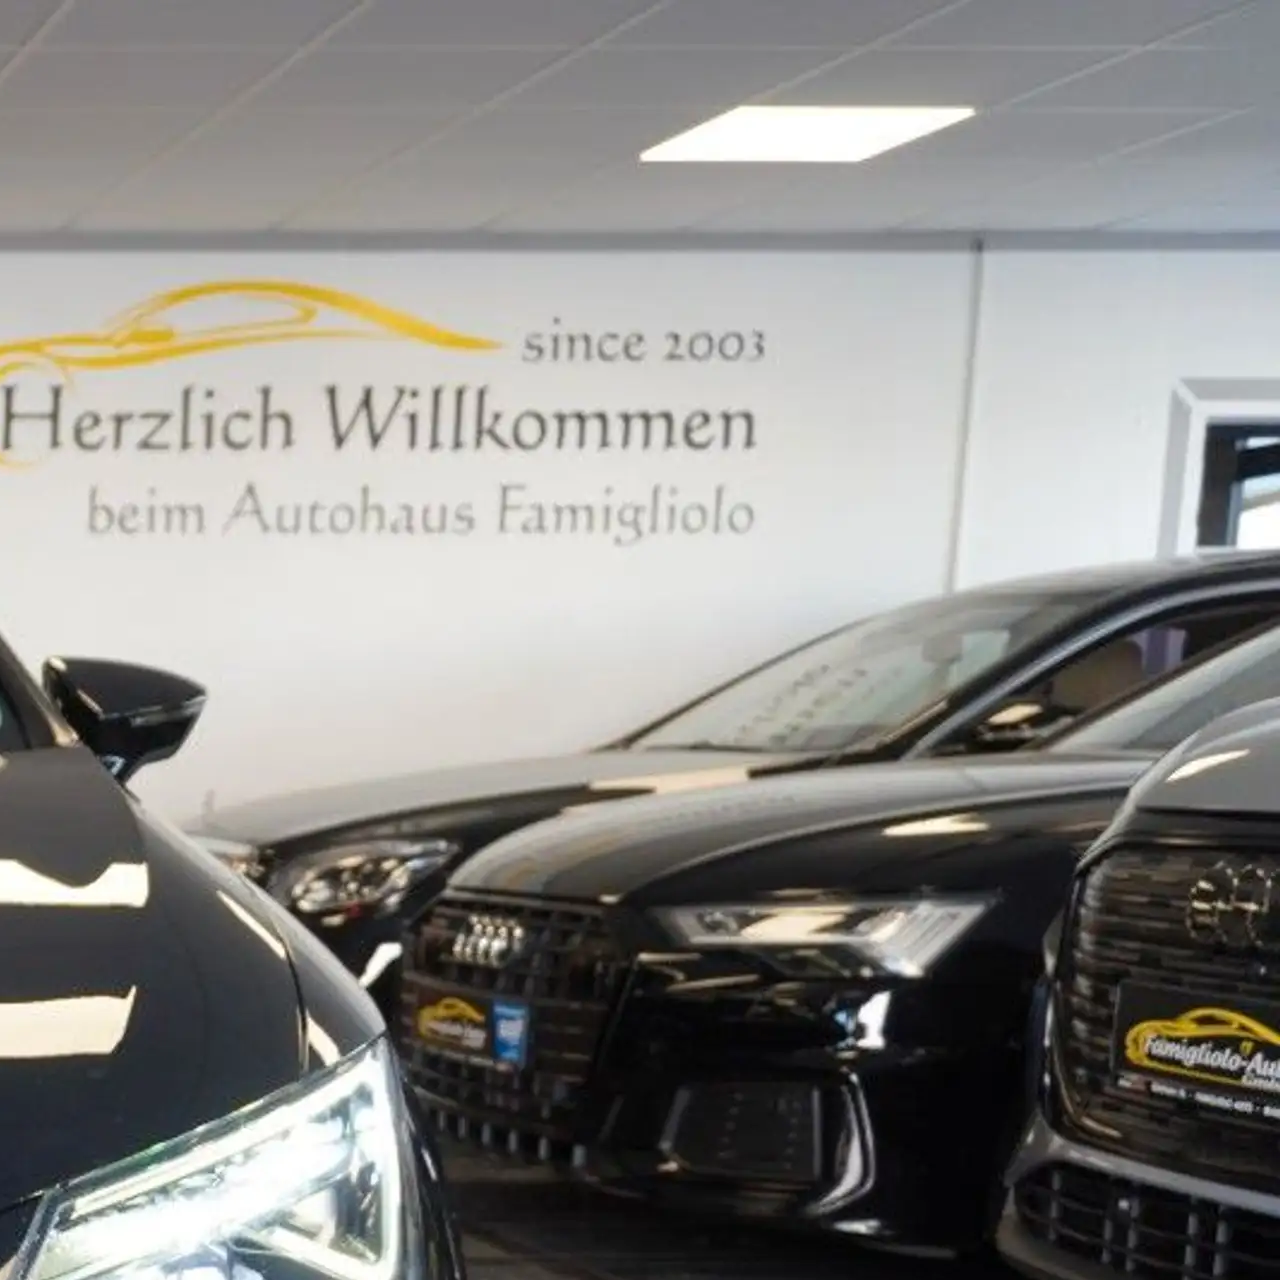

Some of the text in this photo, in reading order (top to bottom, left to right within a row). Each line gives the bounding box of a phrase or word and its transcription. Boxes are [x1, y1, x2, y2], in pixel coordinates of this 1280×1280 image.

[520, 315, 768, 363] since 2003
[1, 382, 759, 453] Herzlich Willkommen
[88, 481, 756, 547] beim Autohaus Famigliolo
